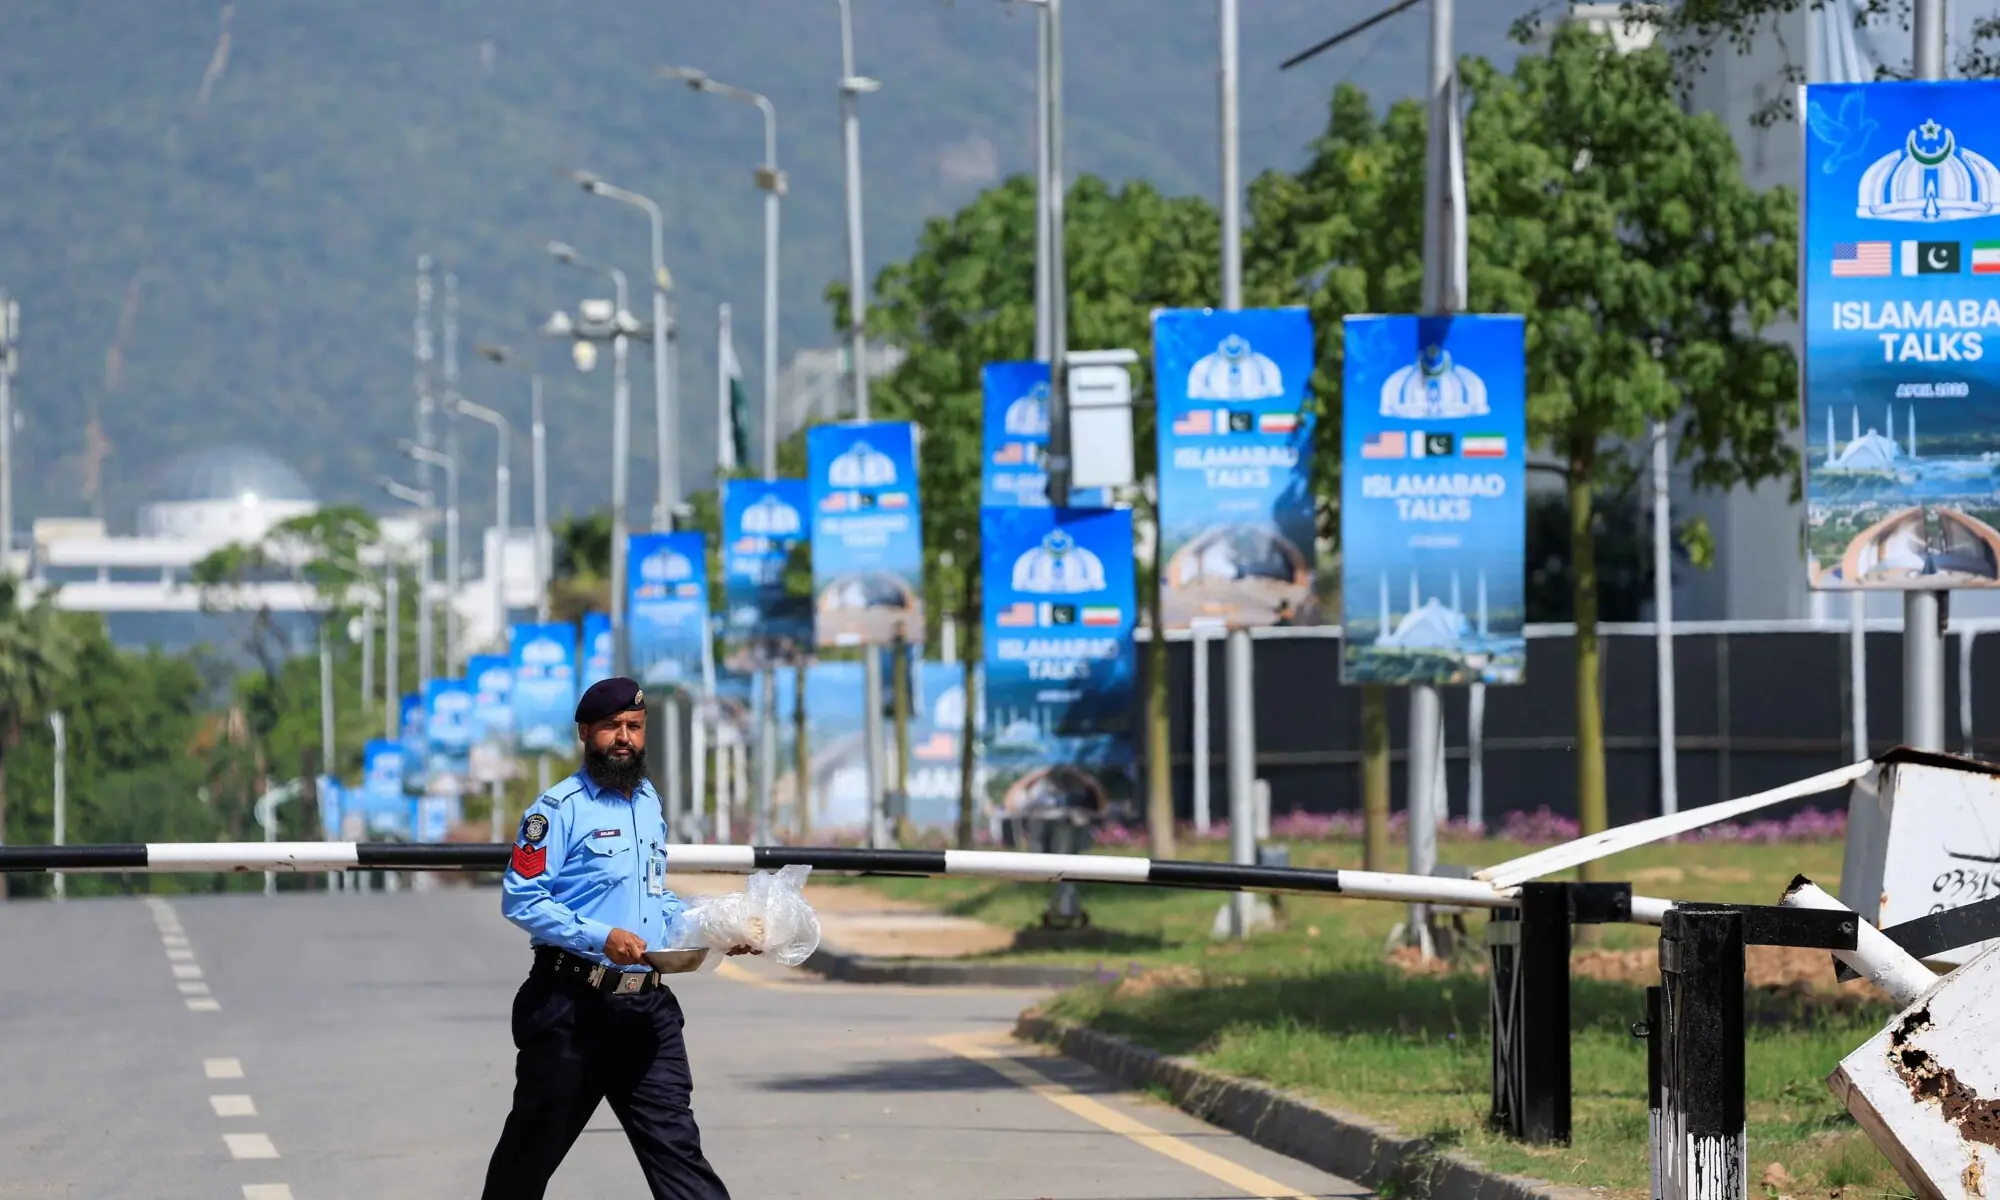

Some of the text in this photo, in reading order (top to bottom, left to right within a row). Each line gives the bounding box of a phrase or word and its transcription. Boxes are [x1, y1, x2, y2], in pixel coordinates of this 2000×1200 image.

[1879, 331, 1983, 362] TALKS
[1895, 383, 1934, 398] APRIL
[1362, 474, 1506, 498] ISLAMABAD
[1396, 498, 1472, 521] TALKS
